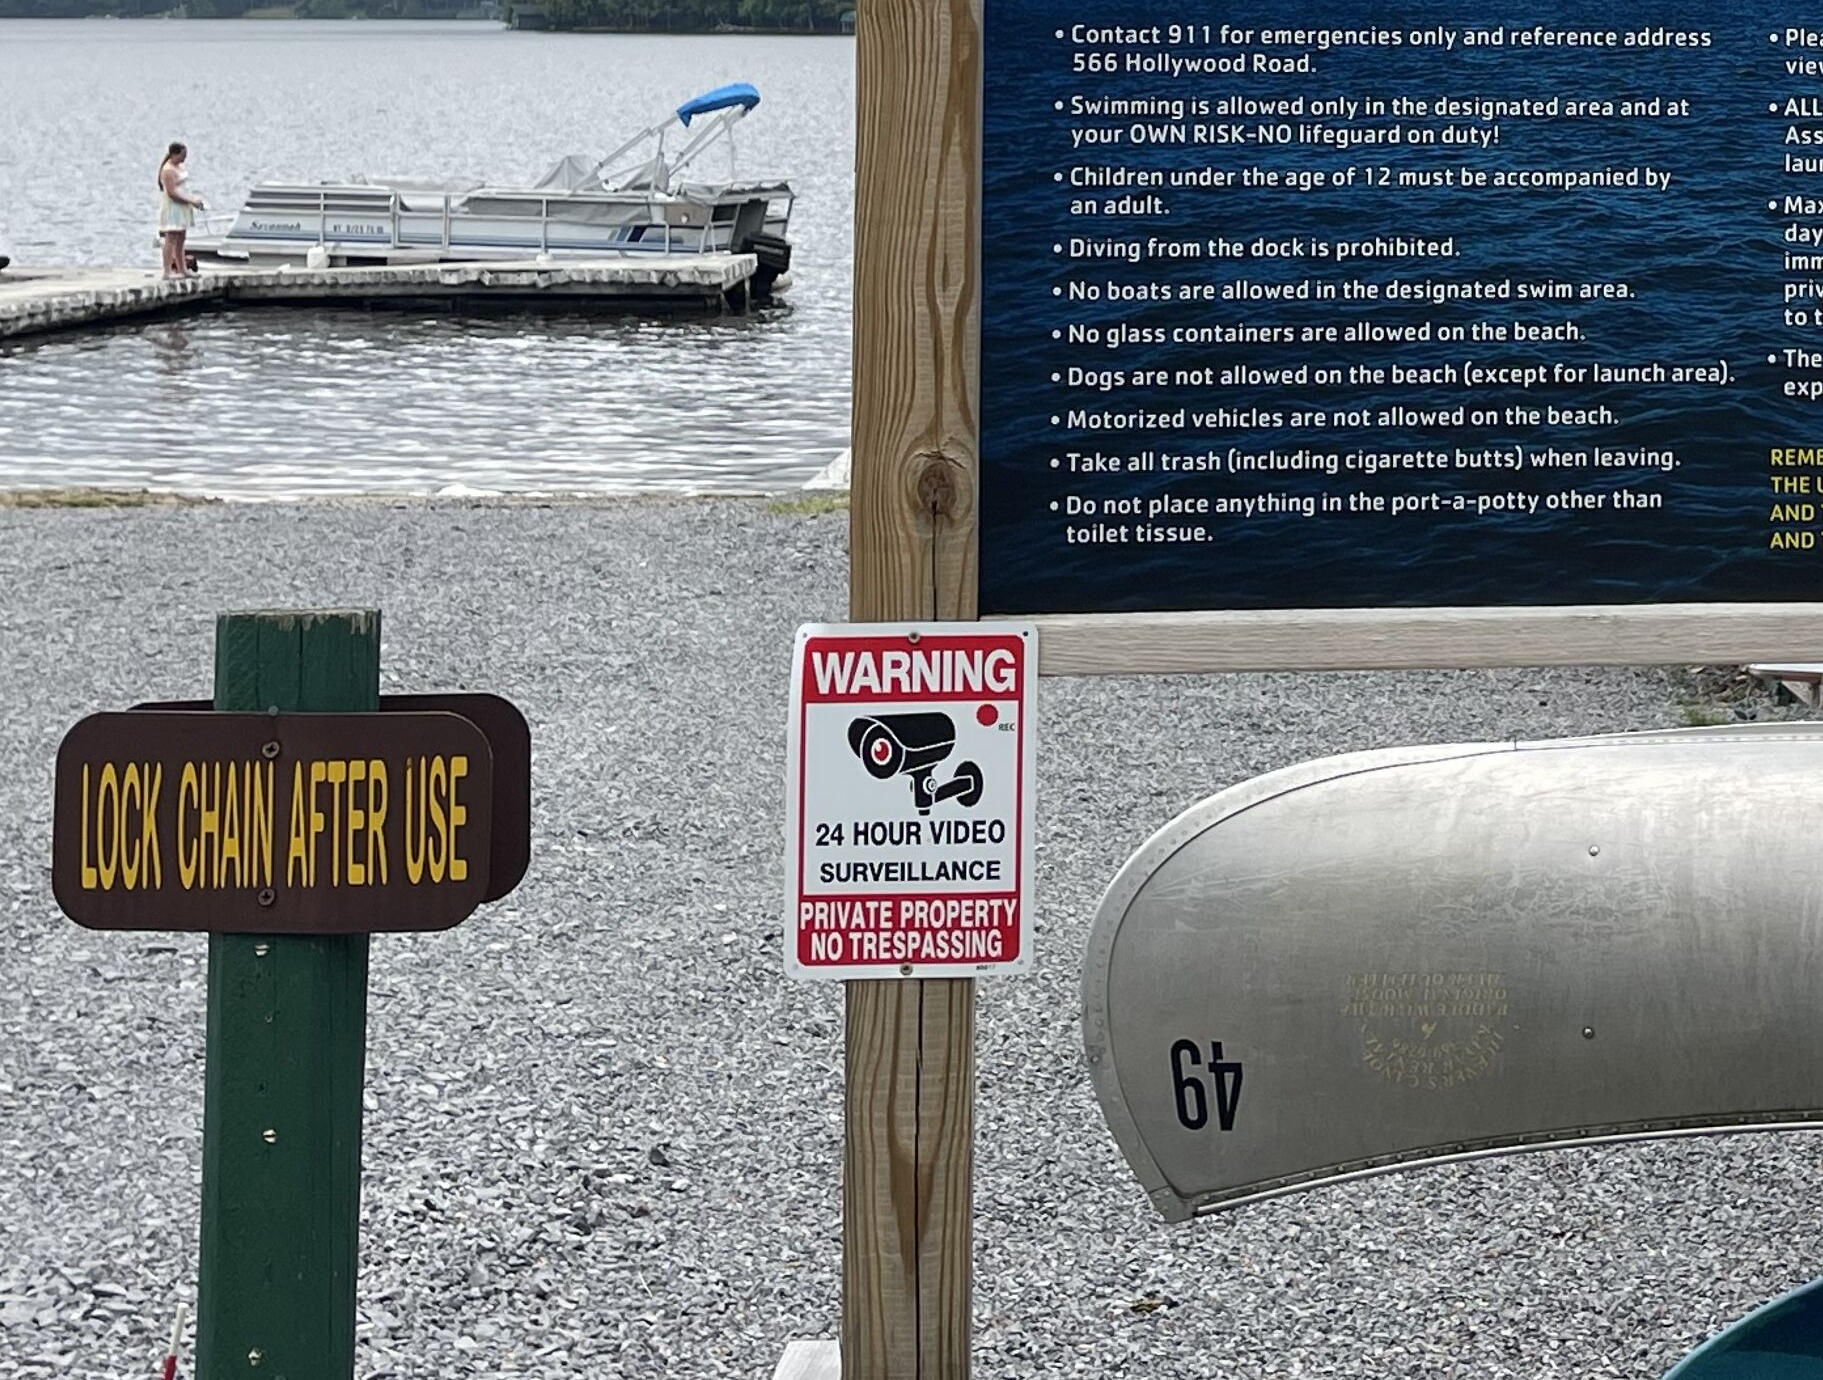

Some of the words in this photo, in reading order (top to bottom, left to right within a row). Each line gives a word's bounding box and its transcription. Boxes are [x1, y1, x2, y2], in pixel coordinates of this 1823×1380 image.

[1072, 24, 1161, 44] Contact
[1168, 24, 1211, 45] 911
[1220, 24, 1254, 45] for
[1261, 25, 1402, 50] emergencies
[1409, 25, 1457, 51] only
[1463, 26, 1504, 46] and
[1510, 26, 1617, 46] reference
[1624, 26, 1712, 47] address
[1073, 52, 1118, 72] 566
[1126, 53, 1246, 77] Hollywood
[1253, 53, 1317, 73] Road.
[1071, 128, 1124, 149] your
[1130, 123, 1186, 144] OWN
[1193, 124, 1292, 144] RISK-NO
[1299, 123, 1401, 149] lifeguard
[1407, 129, 1435, 144] on
[1441, 125, 1499, 149] duty!
[1070, 166, 1163, 186] Children
[1170, 166, 1236, 186] under
[1242, 166, 1279, 186] the
[1285, 171, 1325, 191] age
[1332, 166, 1356, 186] of
[1365, 167, 1391, 186] 12
[1399, 169, 1454, 186] must
[1461, 167, 1487, 186] be
[1493, 167, 1639, 191] accompanied
[1645, 167, 1671, 191] by
[1070, 200, 1097, 214] an
[1103, 194, 1170, 214] adult.
[1070, 238, 1141, 263] Diving
[1147, 237, 1201, 257] from
[1208, 237, 1244, 257] the
[1251, 237, 1305, 257] dock
[1311, 238, 1329, 257] is
[1336, 237, 1461, 262] prohibited.
[1784, 308, 1808, 326] to
[1069, 324, 1100, 343] No
[1106, 323, 1166, 348] glass
[1173, 323, 1294, 343] containers
[1301, 327, 1338, 342] are
[1344, 321, 1431, 342] allowed
[1437, 326, 1465, 341] on
[1471, 321, 1508, 341] the
[1514, 321, 1586, 341] beach.
[1068, 367, 1125, 391] Dogs
[1132, 371, 1169, 386] are
[1175, 367, 1214, 386] not
[1220, 364, 1308, 385] allowed
[1314, 369, 1342, 384] on
[1349, 364, 1385, 384] the
[1392, 363, 1457, 384] beach
[1464, 360, 1547, 388] (except
[1553, 363, 1588, 383] for
[1594, 363, 1665, 383] launch
[1671, 359, 1735, 385] area).
[1066, 452, 1121, 472] Take
[1127, 451, 1154, 472] all
[1161, 451, 1221, 471] trash
[1228, 448, 1338, 475] (including
[1345, 449, 1448, 474] cigarette
[1455, 445, 1523, 471] butts)
[1530, 447, 1587, 467] when
[1594, 447, 1681, 471] leaving.
[1770, 504, 1814, 521] AND
[1066, 523, 1129, 543] toilet
[1135, 523, 1213, 543] tissue.
[1770, 532, 1814, 549] AND
[812, 649, 1017, 695] WARNING
[998, 722, 1016, 732] REC
[80, 760, 162, 891] LOCK
[178, 758, 275, 888] CHAIN
[285, 757, 388, 888] AFTER
[404, 756, 469, 882] USE
[815, 822, 844, 846] 24
[853, 821, 921, 846] HOUR
[931, 820, 1005, 845] VIDEO
[820, 860, 1001, 883] SURVEILLANCE
[800, 901, 893, 930] PRIVATE
[900, 898, 1017, 928] PROPERTY
[811, 932, 843, 961] NO
[849, 929, 1002, 960] TRESPASSING
[1169, 1038, 1244, 1132] 49
